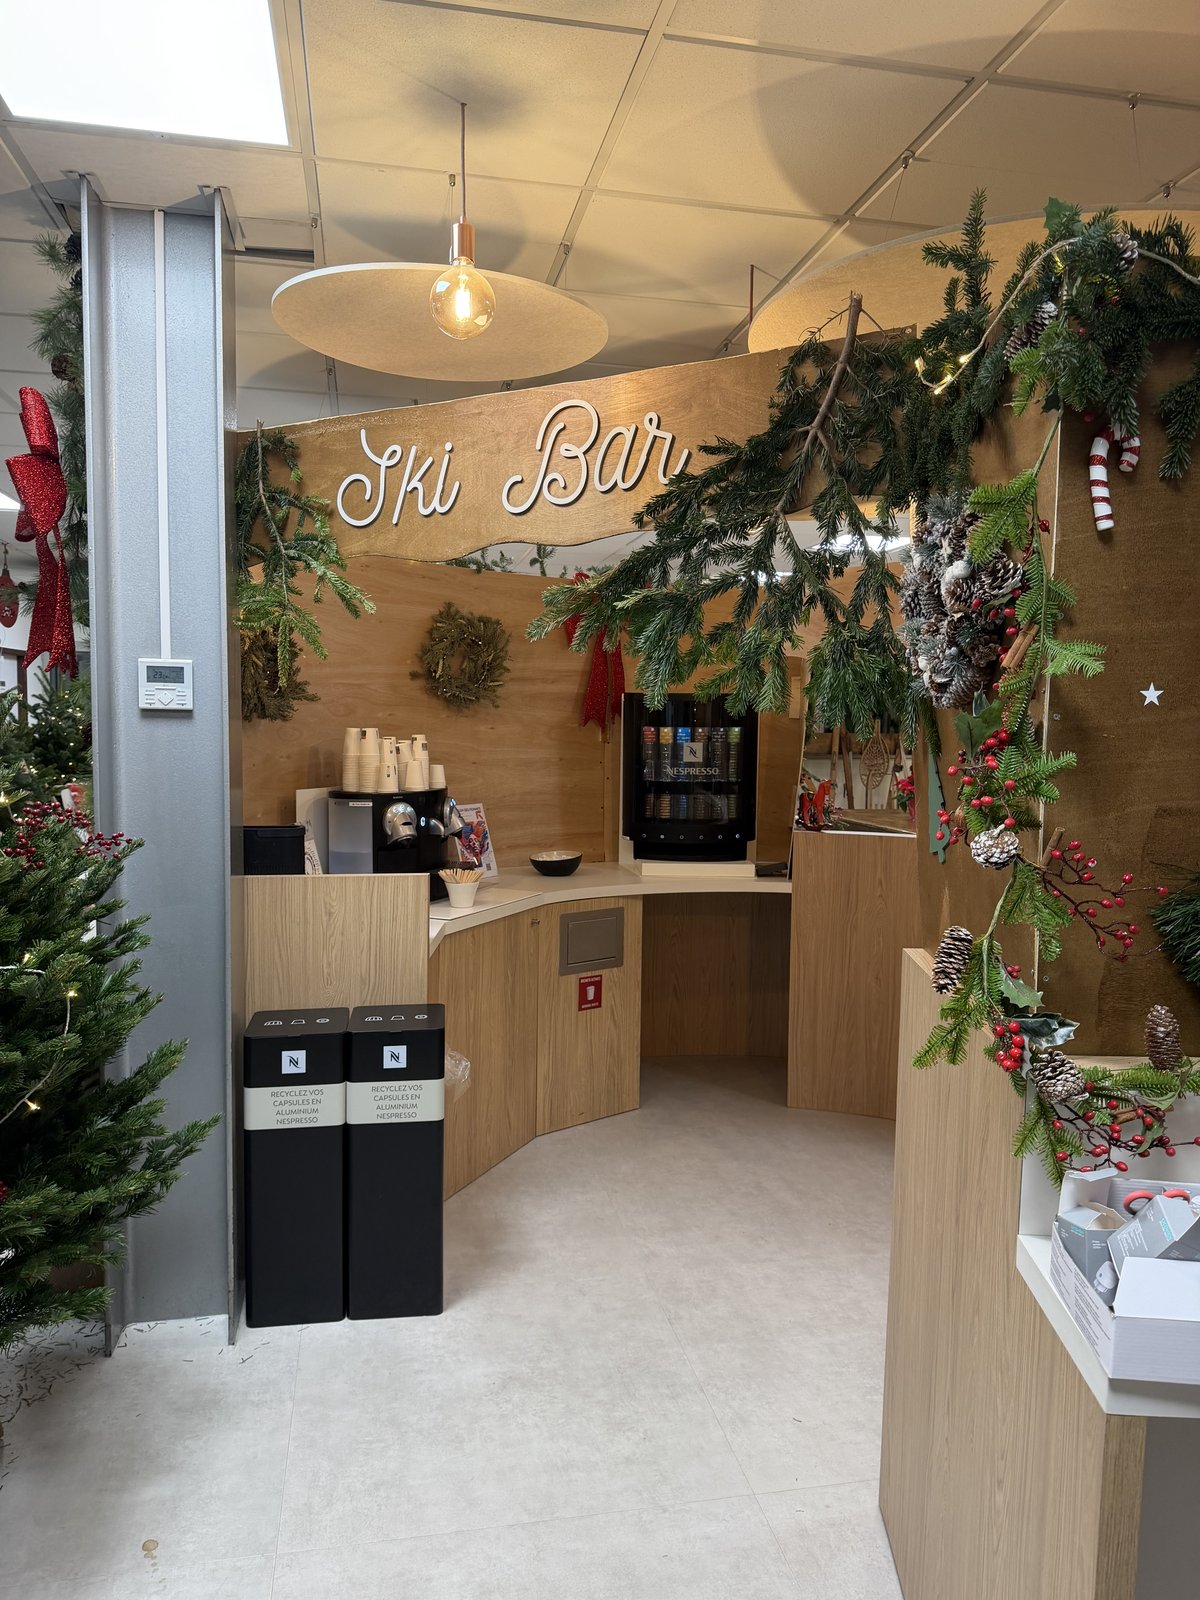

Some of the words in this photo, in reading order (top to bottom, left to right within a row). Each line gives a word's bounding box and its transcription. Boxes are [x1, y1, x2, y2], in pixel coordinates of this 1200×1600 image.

[337, 428, 461, 528] Ski
[501, 398, 692, 515] Bar
[663, 764, 719, 778] NESPRESSO
[270, 1089, 308, 1098] RECYCLEZ
[309, 1088, 324, 1096] VOS
[371, 1084, 407, 1093] RECYCLEZ
[373, 1093, 410, 1102] CAPSULES
[410, 1093, 421, 1101] EN
[272, 1098, 311, 1107] CAPSULES
[375, 1103, 418, 1111] ALUMINIUM
[275, 1107, 320, 1116] ALUMINIUM
[376, 1111, 418, 1120] NESPRESSO
[276, 1116, 319, 1125] NESPRESSO
